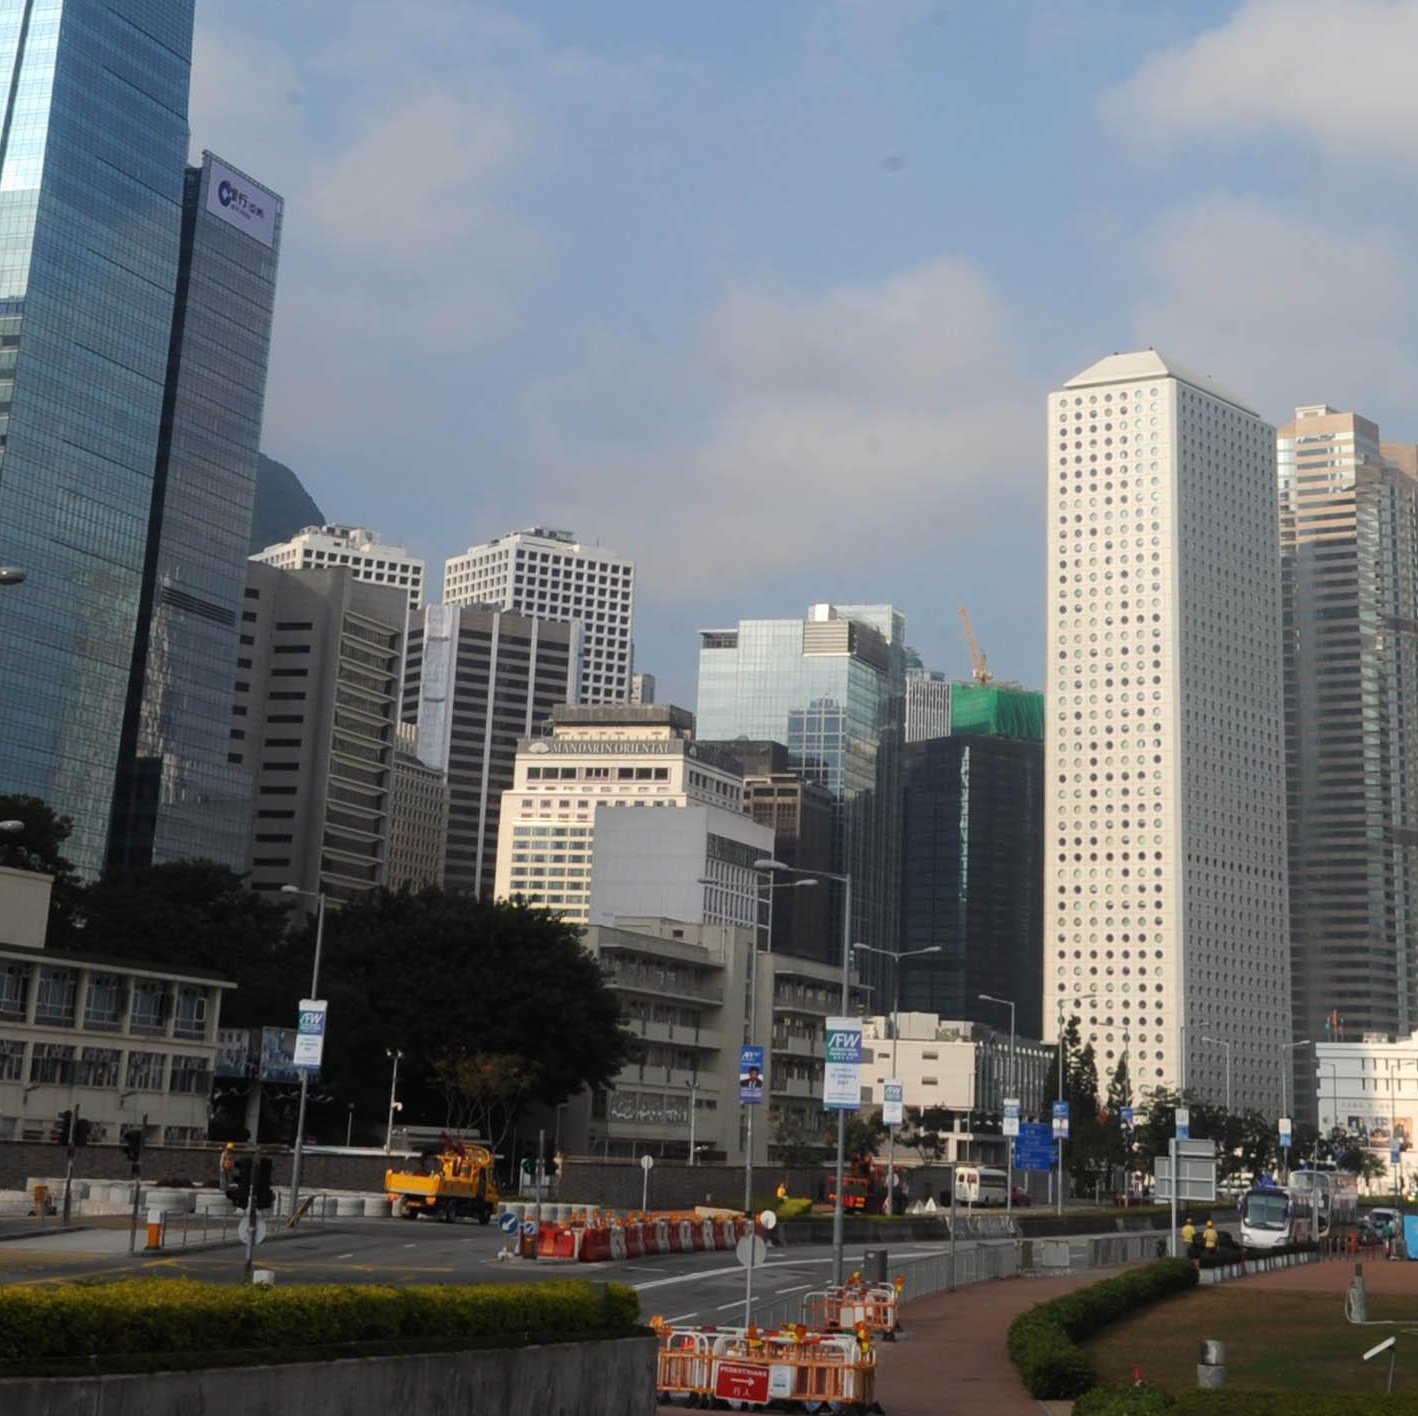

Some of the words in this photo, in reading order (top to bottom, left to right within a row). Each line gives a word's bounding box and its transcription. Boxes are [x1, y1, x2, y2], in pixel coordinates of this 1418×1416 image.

[552, 742, 613, 753] MANDARIN
[614, 742, 669, 753] ORIENTAL
[720, 1365, 767, 1377] PEDESTRIANS
[733, 1386, 750, 1398] 行人
